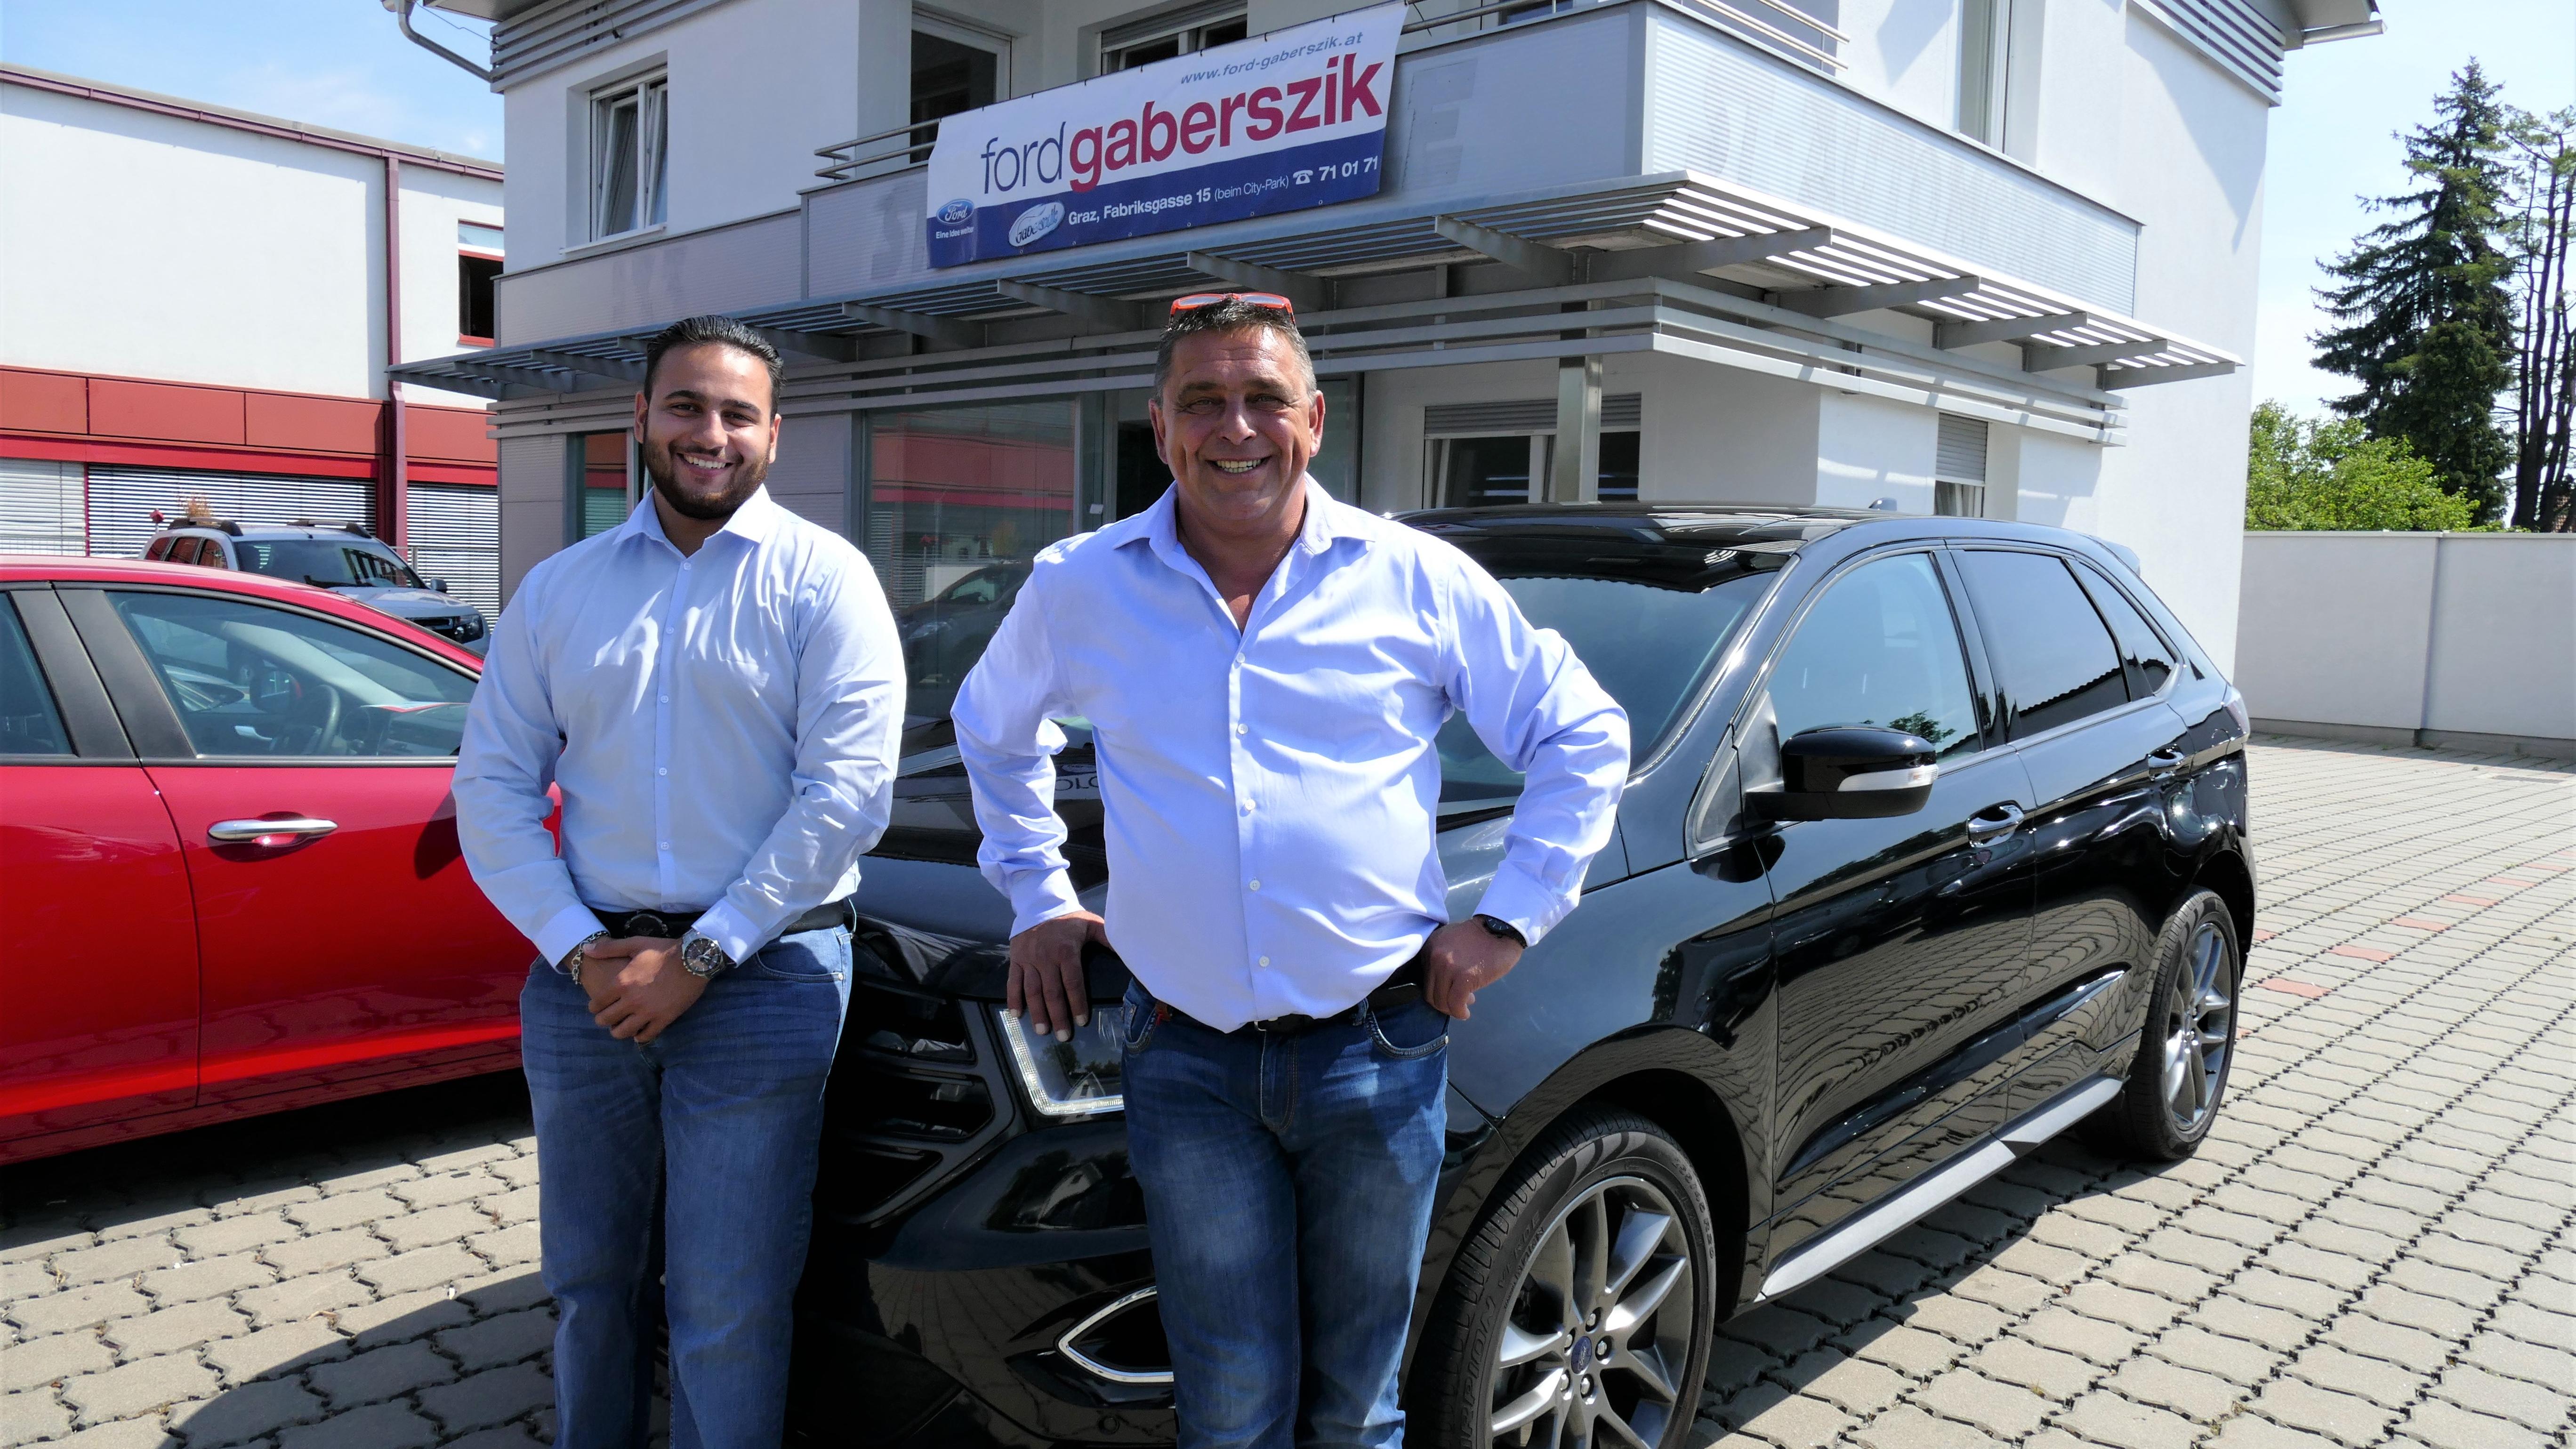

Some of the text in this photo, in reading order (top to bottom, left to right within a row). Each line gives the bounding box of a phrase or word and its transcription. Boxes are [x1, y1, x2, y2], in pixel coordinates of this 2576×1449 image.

[1181, 32, 1364, 84] www.ford-gaberszik.at
[1068, 156, 1378, 225] Graz, Fabriksgasse 15 (beim City-Park) 71 01 71
[945, 204, 968, 221] Ford
[950, 229, 960, 237] Idee
